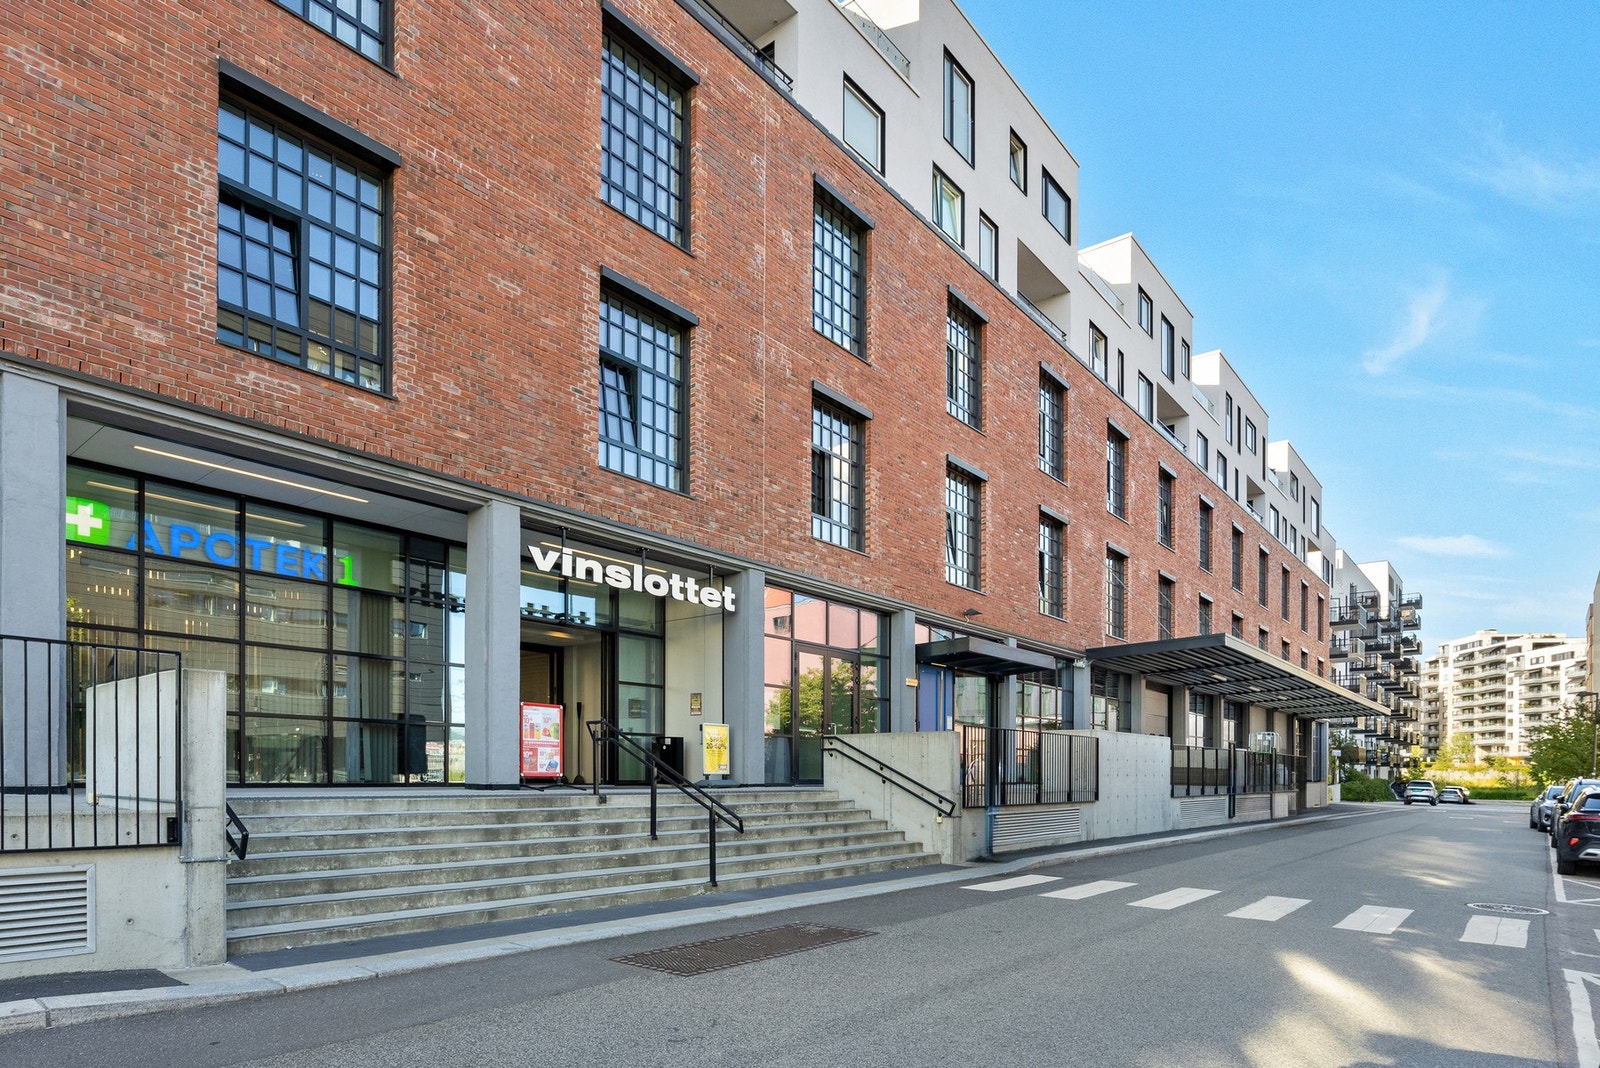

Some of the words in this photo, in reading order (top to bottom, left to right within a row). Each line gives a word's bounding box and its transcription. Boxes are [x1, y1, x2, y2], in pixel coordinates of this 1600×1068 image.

[126, 518, 325, 581] APOTEK
[337, 555, 359, 586] 1
[527, 545, 736, 612] vinslottet
